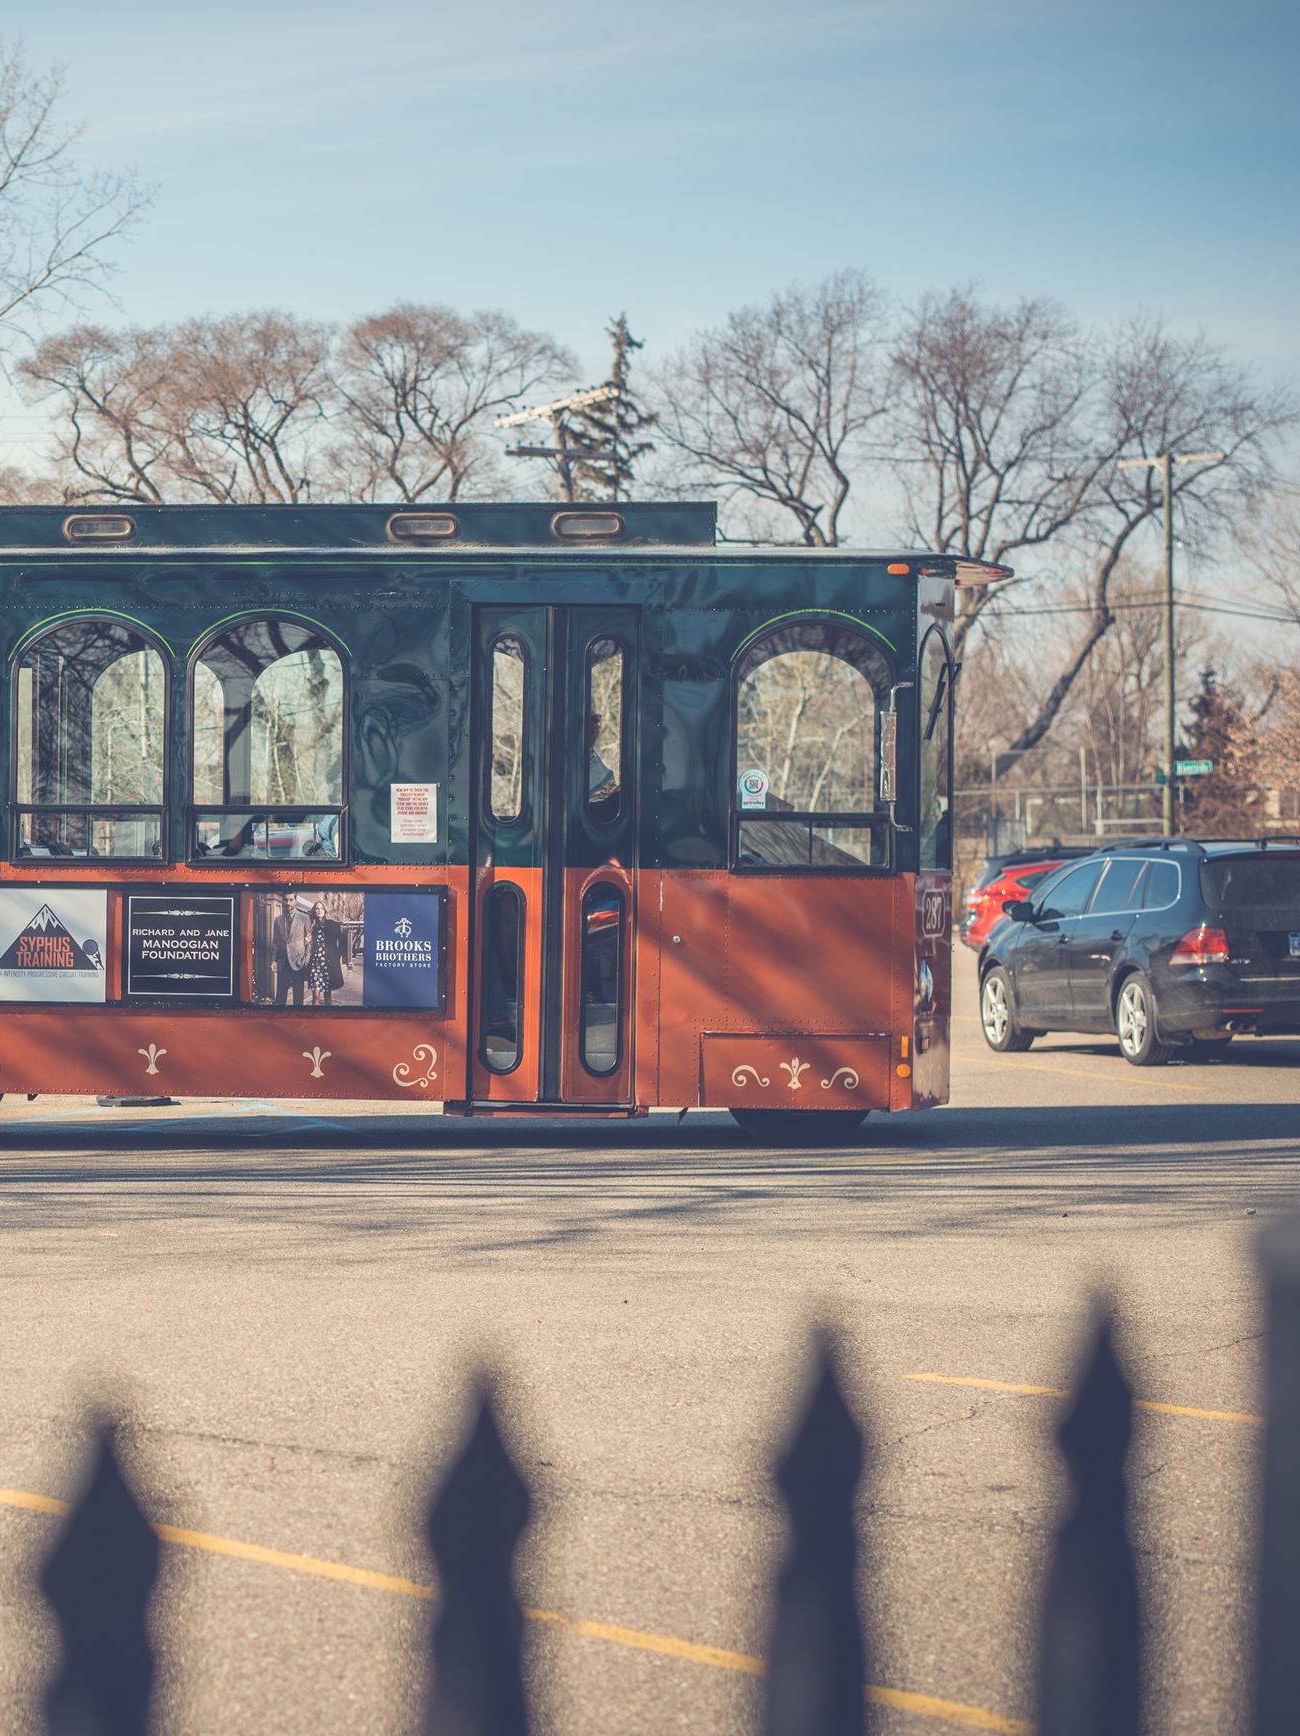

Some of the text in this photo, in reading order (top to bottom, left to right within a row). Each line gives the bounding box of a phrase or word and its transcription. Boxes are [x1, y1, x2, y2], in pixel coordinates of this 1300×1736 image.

[926, 896, 942, 928] 287
[132, 928, 175, 936] RICHARD
[20, 936, 70, 952] SYPHUS
[143, 940, 219, 949] MANOOGIAN
[376, 940, 432, 952] BROOKS
[16, 952, 74, 968] TRAINING
[142, 951, 220, 960] FOUNDATION
[376, 952, 432, 961] BROTHERS
